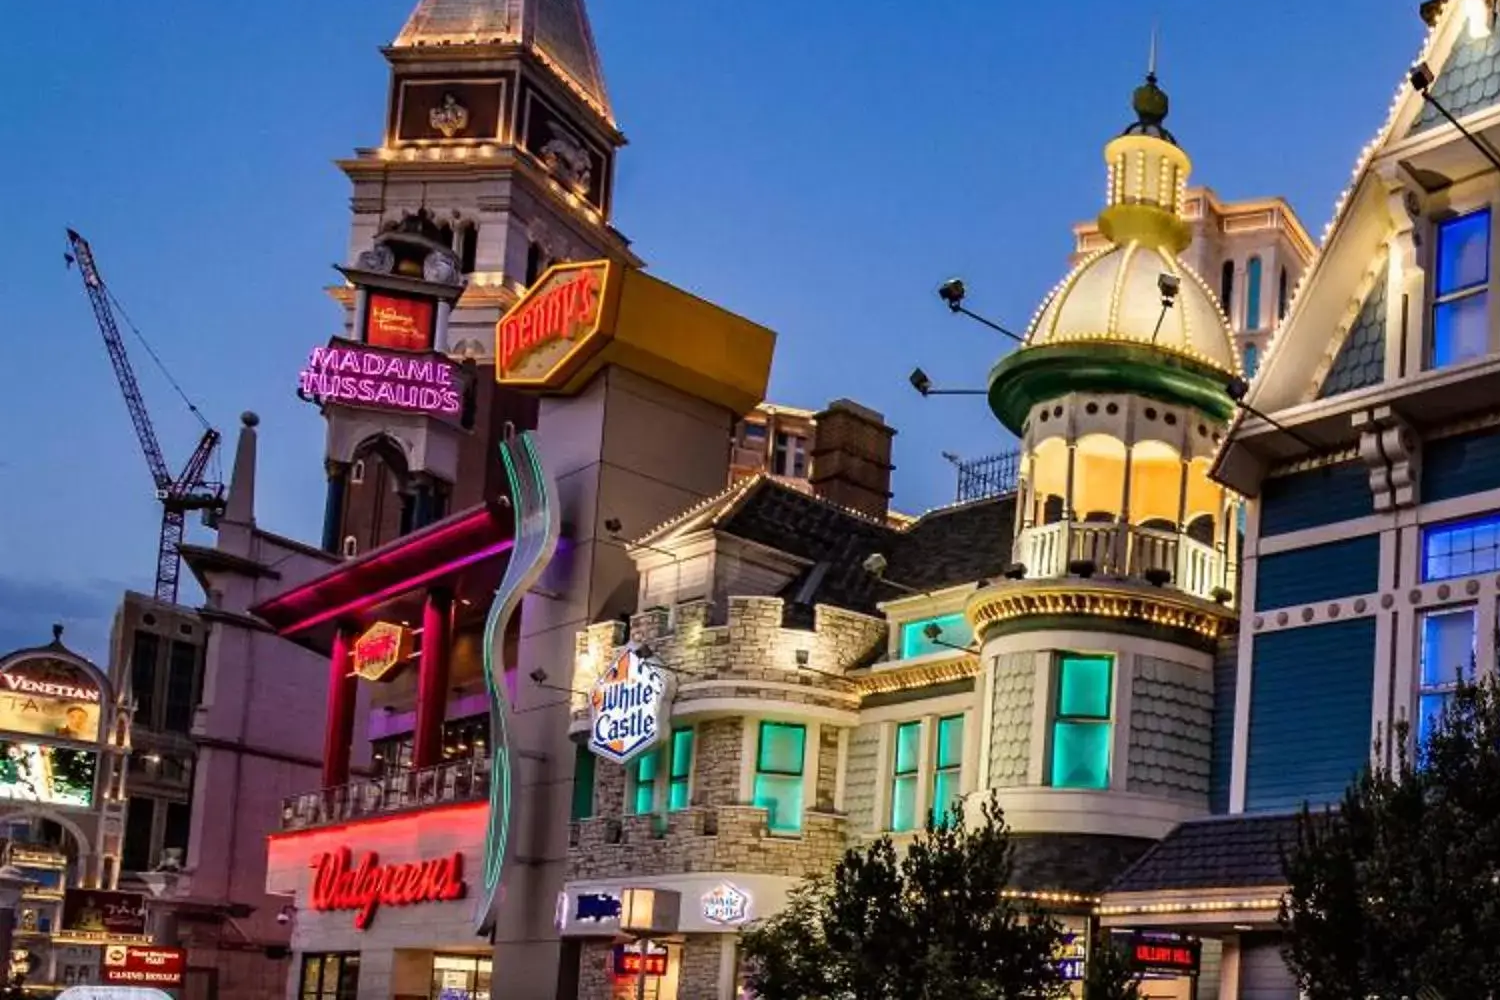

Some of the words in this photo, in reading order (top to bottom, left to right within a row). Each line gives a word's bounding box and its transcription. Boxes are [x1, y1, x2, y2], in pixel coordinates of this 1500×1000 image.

[501, 268, 599, 368] Denny's
[311, 348, 452, 385] MADAME
[3, 673, 99, 700] VENETIAN
[601, 682, 653, 713] White
[596, 708, 654, 741] Castle
[308, 845, 467, 931] Walgreens
